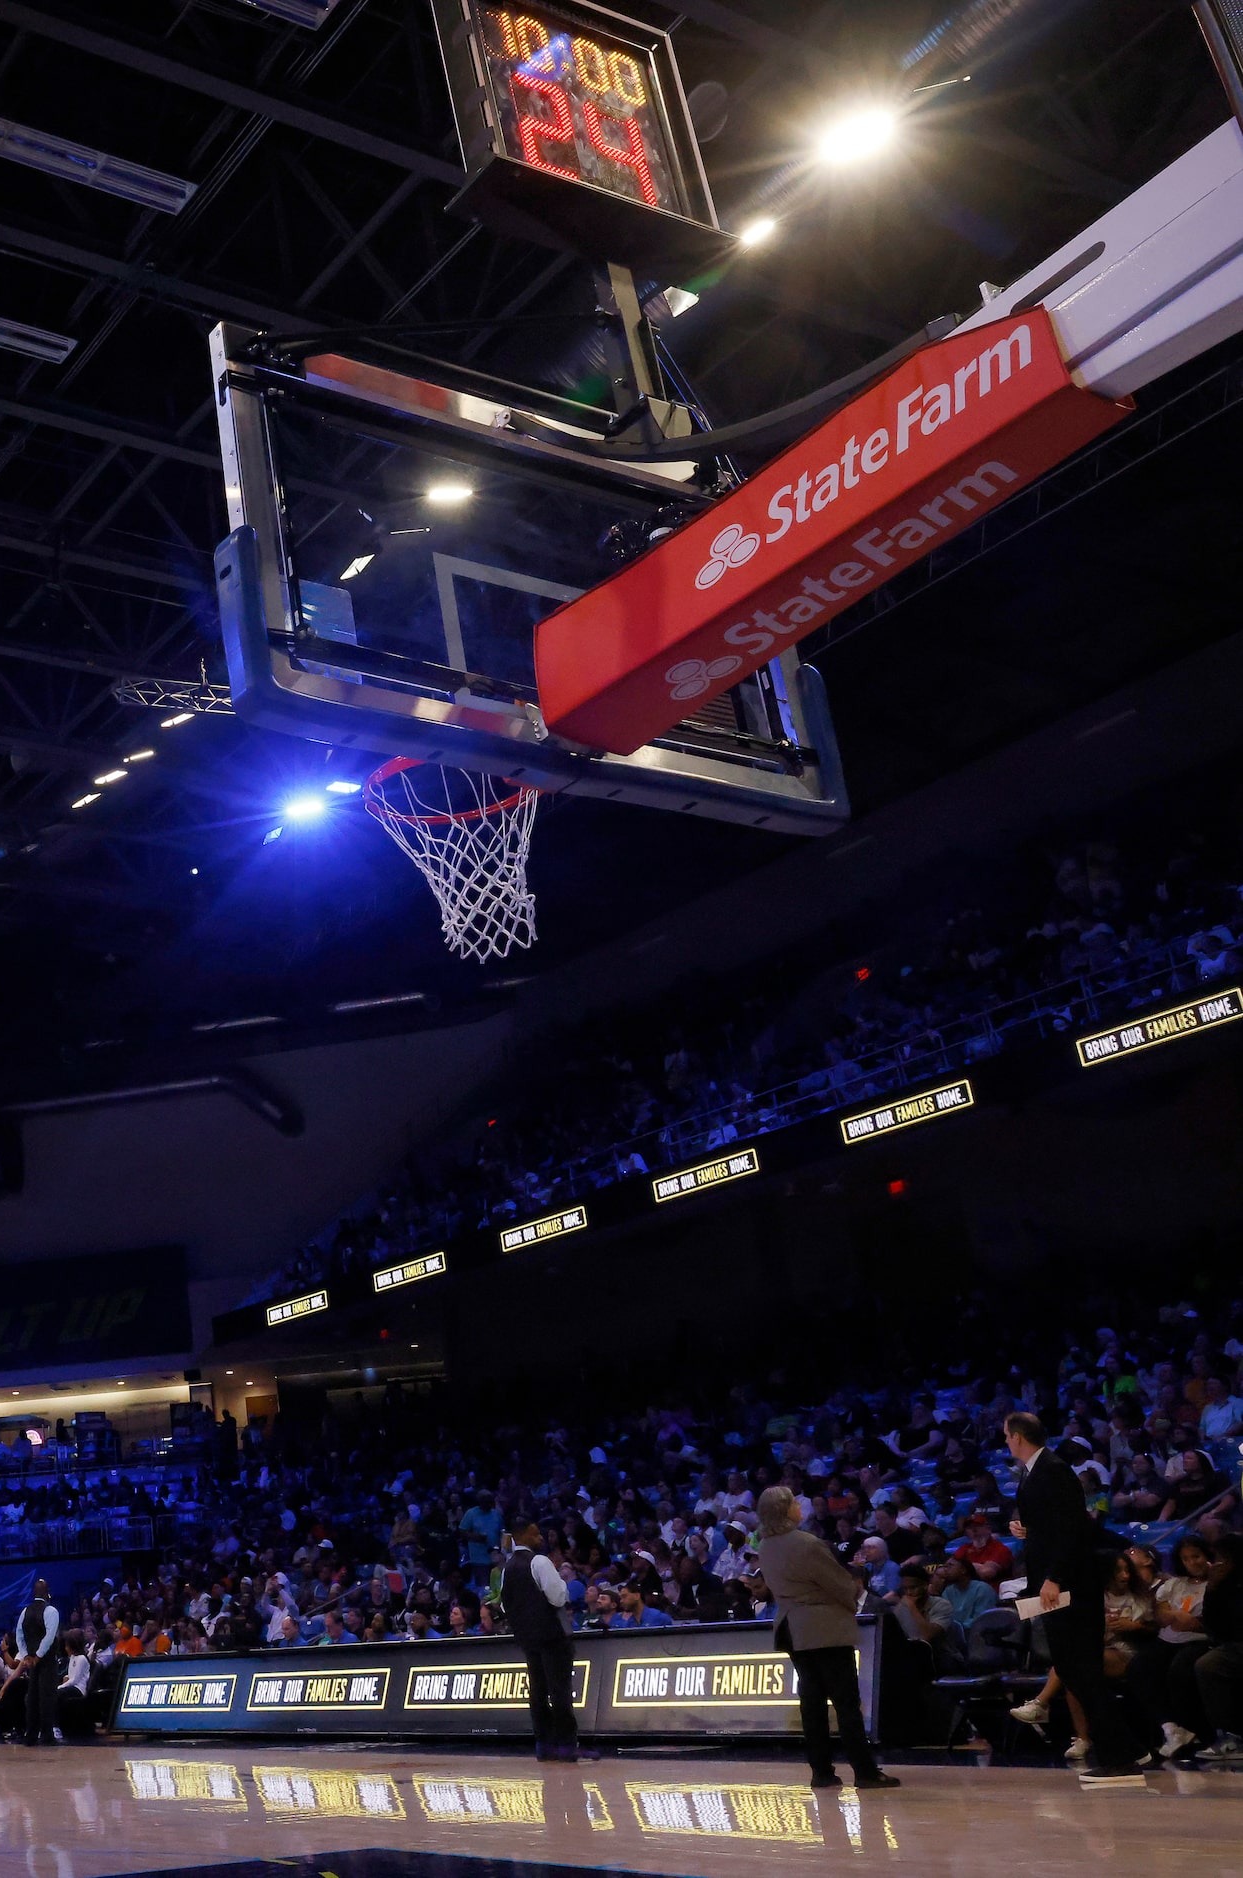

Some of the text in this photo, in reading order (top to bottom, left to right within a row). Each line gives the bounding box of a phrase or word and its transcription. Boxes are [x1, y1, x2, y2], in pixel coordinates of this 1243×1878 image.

[500, 12, 647, 108] 10:00
[511, 71, 658, 207] 24
[1084, 997, 1239, 1060] BRING OUR FAMILIES HOME.
[847, 1087, 966, 1138] BRING OUR FAMILIES HOME.
[658, 1180, 679, 1197] BRING
[681, 1175, 696, 1191] OUR
[697, 1164, 729, 1186] FAMILIES
[127, 1682, 226, 1705] BRING OUR FAMILIES HOME.
[255, 1677, 379, 1703] BRING OUR FAMILIES HOME.
[413, 1674, 447, 1700] BRING
[451, 1673, 476, 1699] OUR
[624, 1667, 668, 1697] BRING
[674, 1666, 706, 1696] OUR
[712, 1663, 784, 1695] FAMILIES
